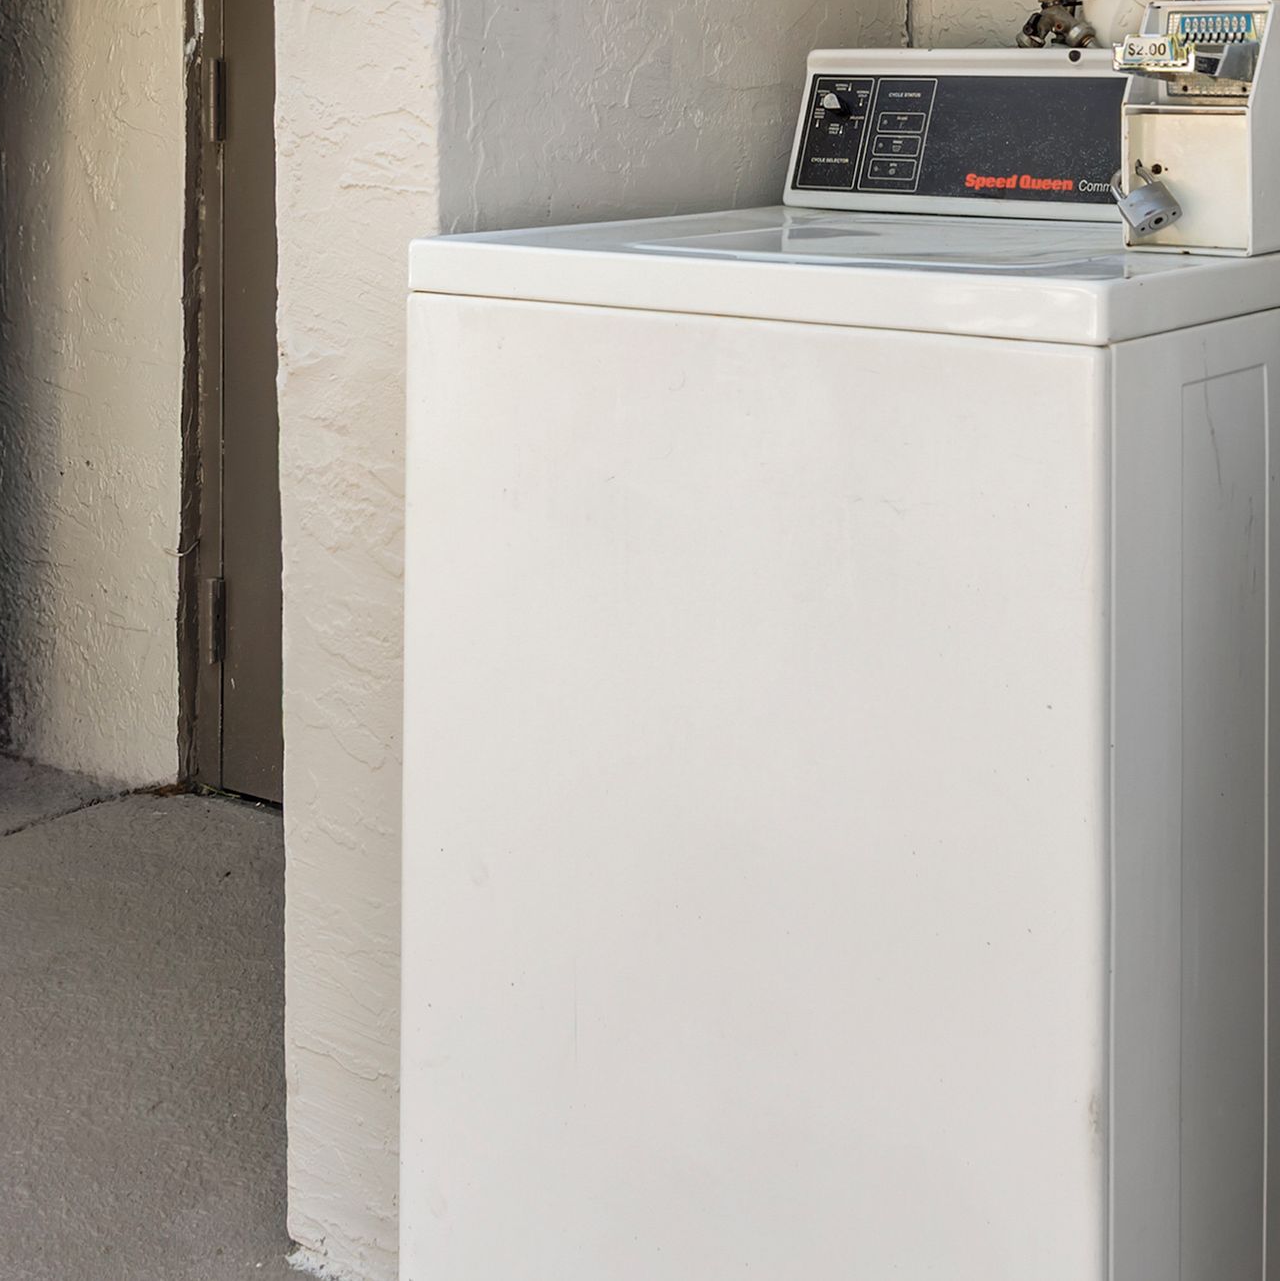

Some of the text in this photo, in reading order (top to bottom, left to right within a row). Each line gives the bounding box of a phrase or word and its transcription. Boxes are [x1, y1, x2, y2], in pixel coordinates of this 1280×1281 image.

[1128, 42, 1167, 57] $2.00
[965, 173, 1018, 190] Speed
[1019, 174, 1074, 191] Queen
